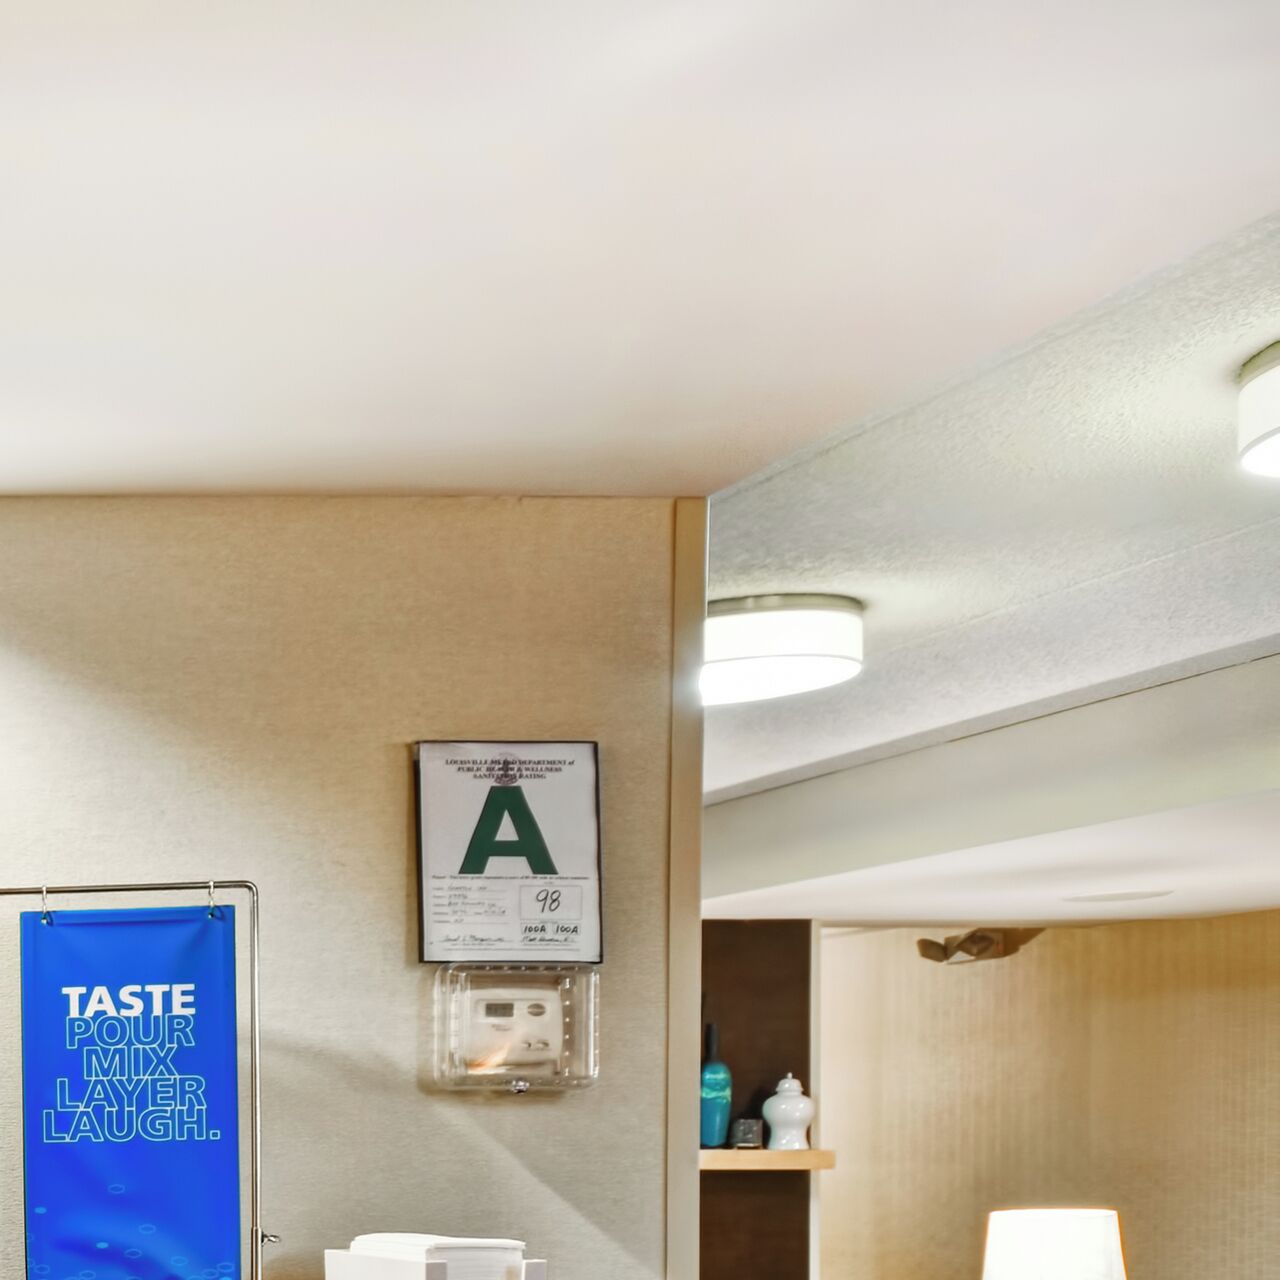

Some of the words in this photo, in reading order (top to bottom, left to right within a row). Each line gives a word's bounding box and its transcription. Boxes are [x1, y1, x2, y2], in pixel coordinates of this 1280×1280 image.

[458, 785, 559, 875] A
[535, 888, 562, 914] 98
[61, 983, 196, 1018] TASTE
[66, 1013, 196, 1049] POUR
[83, 1044, 179, 1080] MIX
[56, 1075, 208, 1112] LAYER
[42, 1106, 221, 1143] LAUGH.
